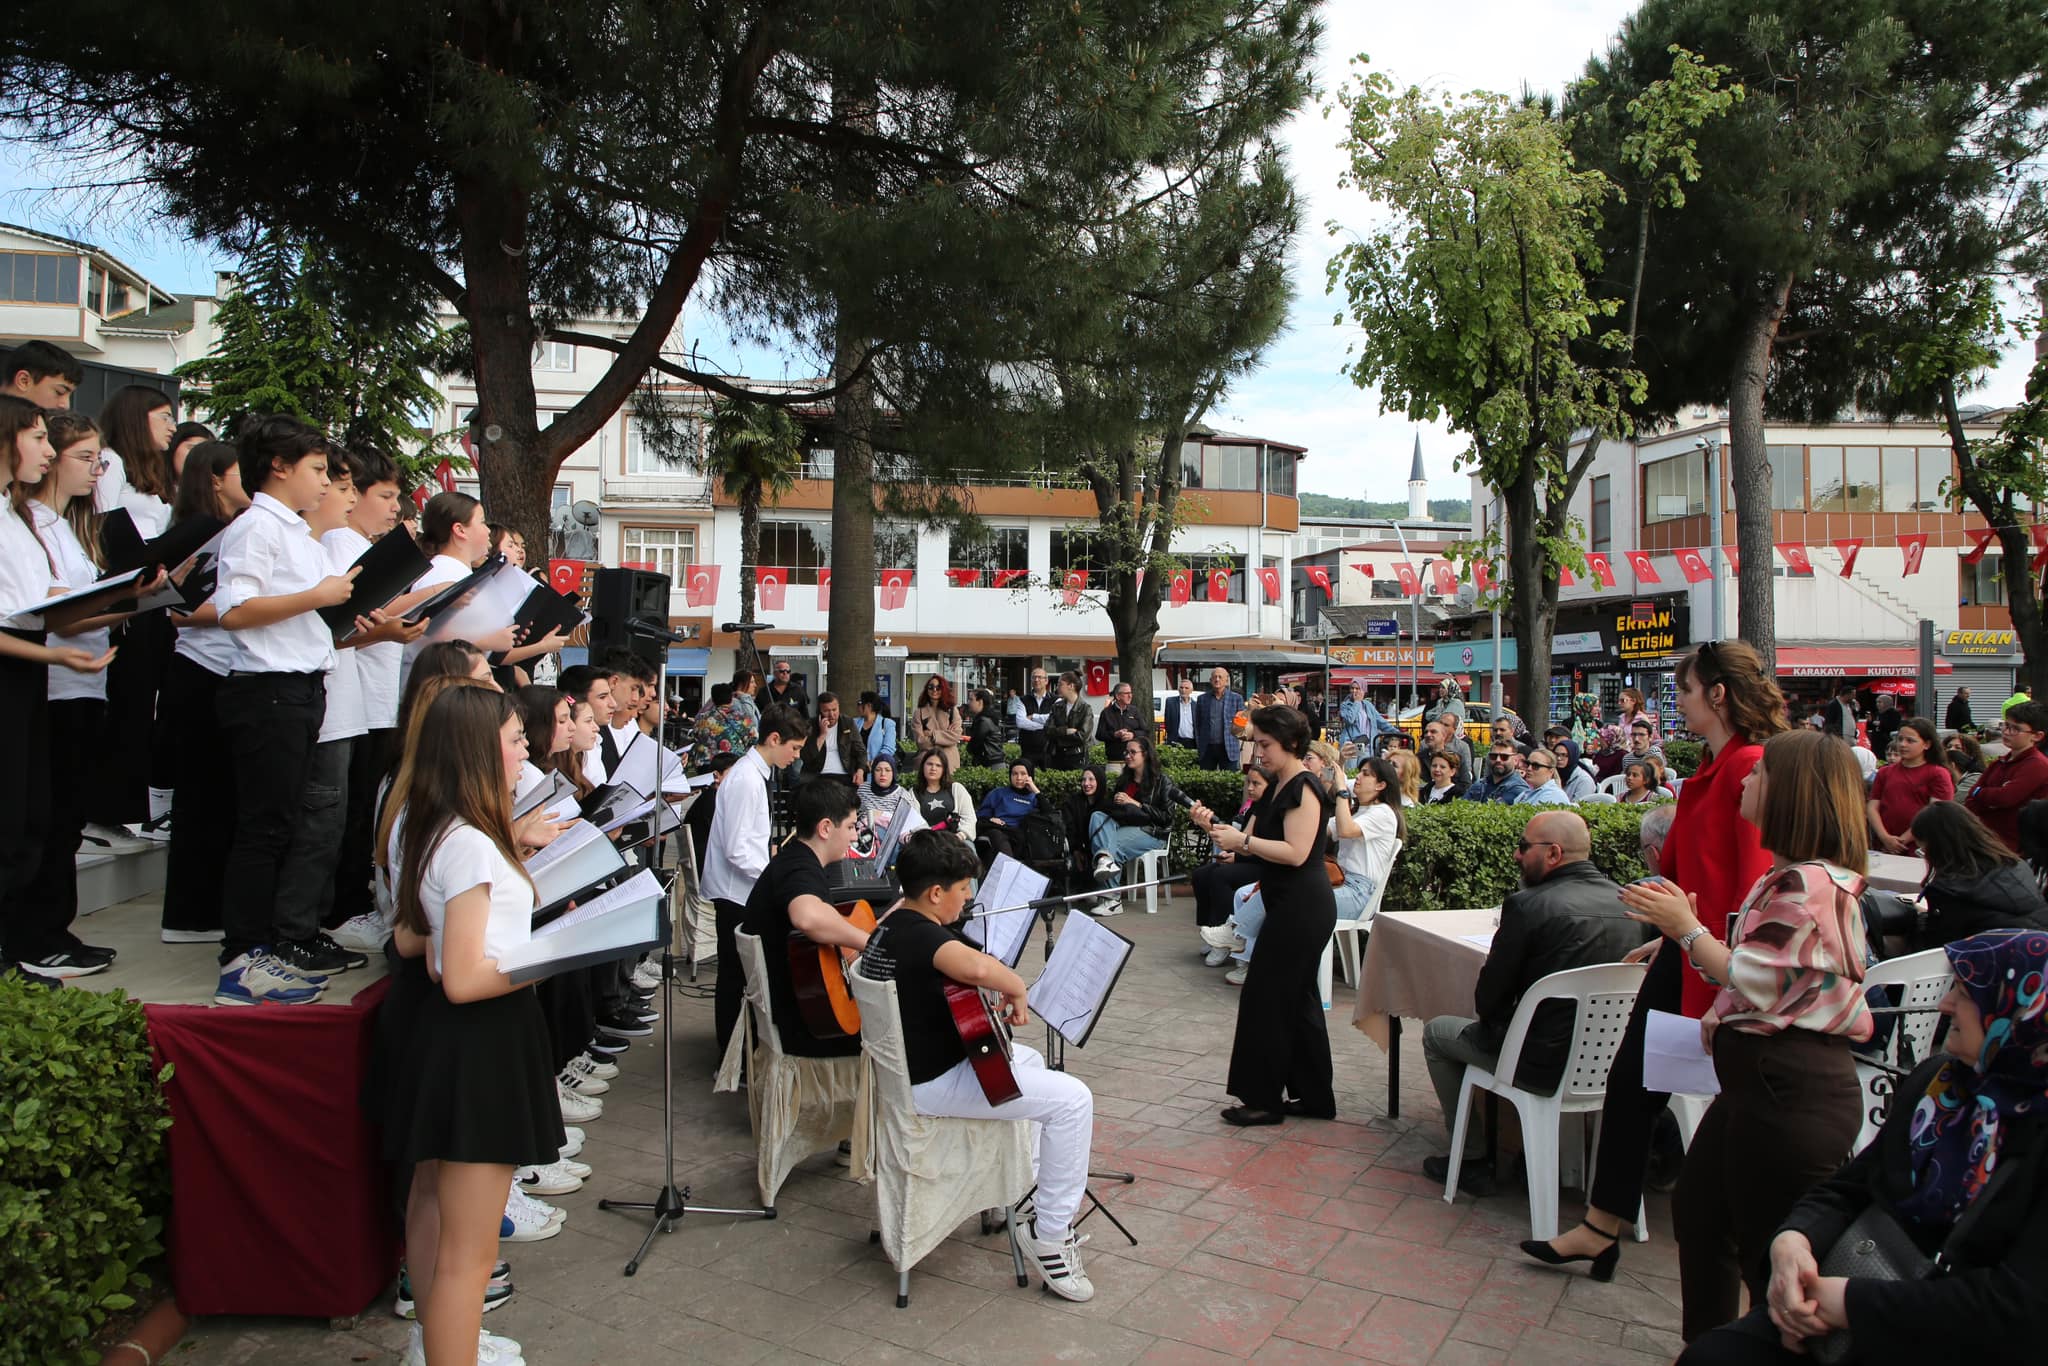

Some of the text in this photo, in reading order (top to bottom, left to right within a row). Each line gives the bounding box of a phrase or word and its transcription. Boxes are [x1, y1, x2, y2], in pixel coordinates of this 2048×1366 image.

[1616, 611, 1670, 632] ERKAN
[1621, 631, 1674, 651] İLETİŞİM
[1946, 631, 2014, 645] ERKAN
[1793, 668, 1846, 676] KARAKAYA
